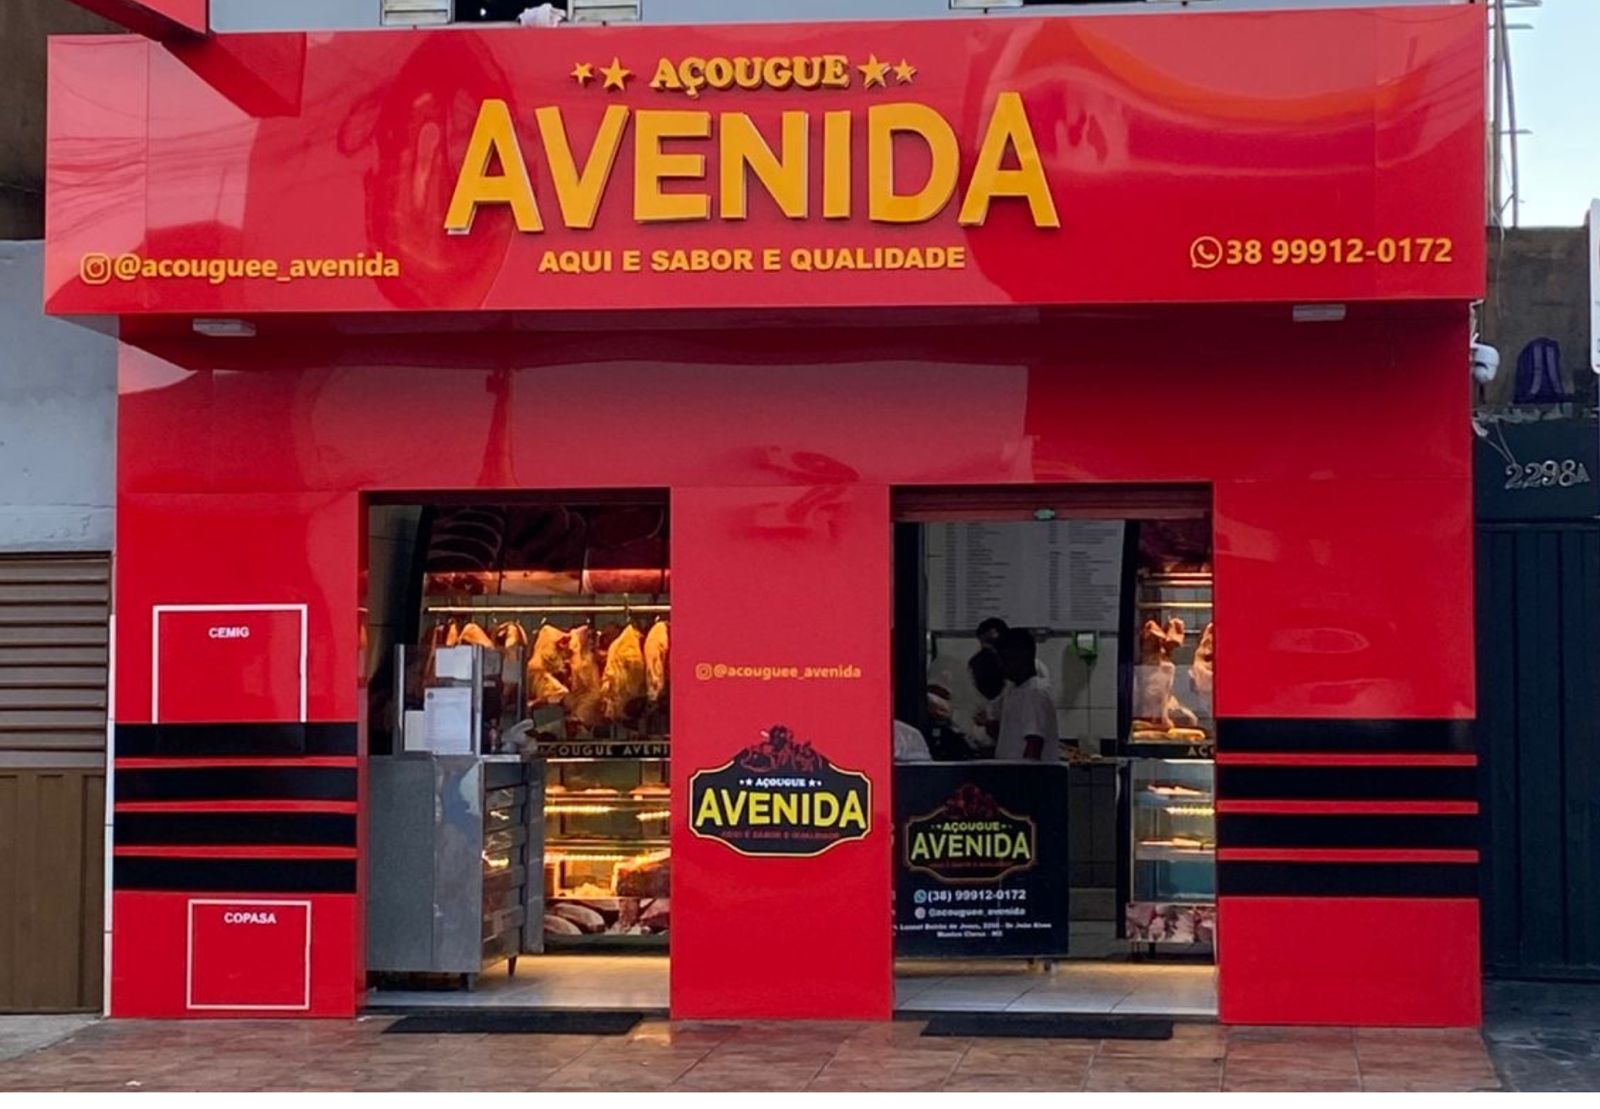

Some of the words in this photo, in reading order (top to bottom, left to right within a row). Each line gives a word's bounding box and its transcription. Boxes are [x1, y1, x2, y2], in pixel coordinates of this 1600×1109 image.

[649, 54, 849, 99] AÇOUGUE
[443, 91, 1061, 235] AVENIDA
[538, 250, 612, 274] AQUI
[622, 250, 641, 272] E
[651, 248, 754, 272] SABOR
[763, 248, 782, 270] E
[790, 246, 966, 272] QUALIDADE
[1226, 239, 1263, 265] 38
[1271, 237, 1453, 265] 99912-0172
[114, 252, 399, 284] @acouguee_avenida
[208, 626, 250, 638] CEMIG
[713, 663, 862, 681] @acouguee_avenida
[755, 777, 806, 789] AÇOUGUE
[695, 788, 867, 829] AVENIDA
[943, 821, 1000, 833] AÇOUGUE
[911, 832, 1031, 861] AVENIDA
[224, 912, 277, 924] COPASA
